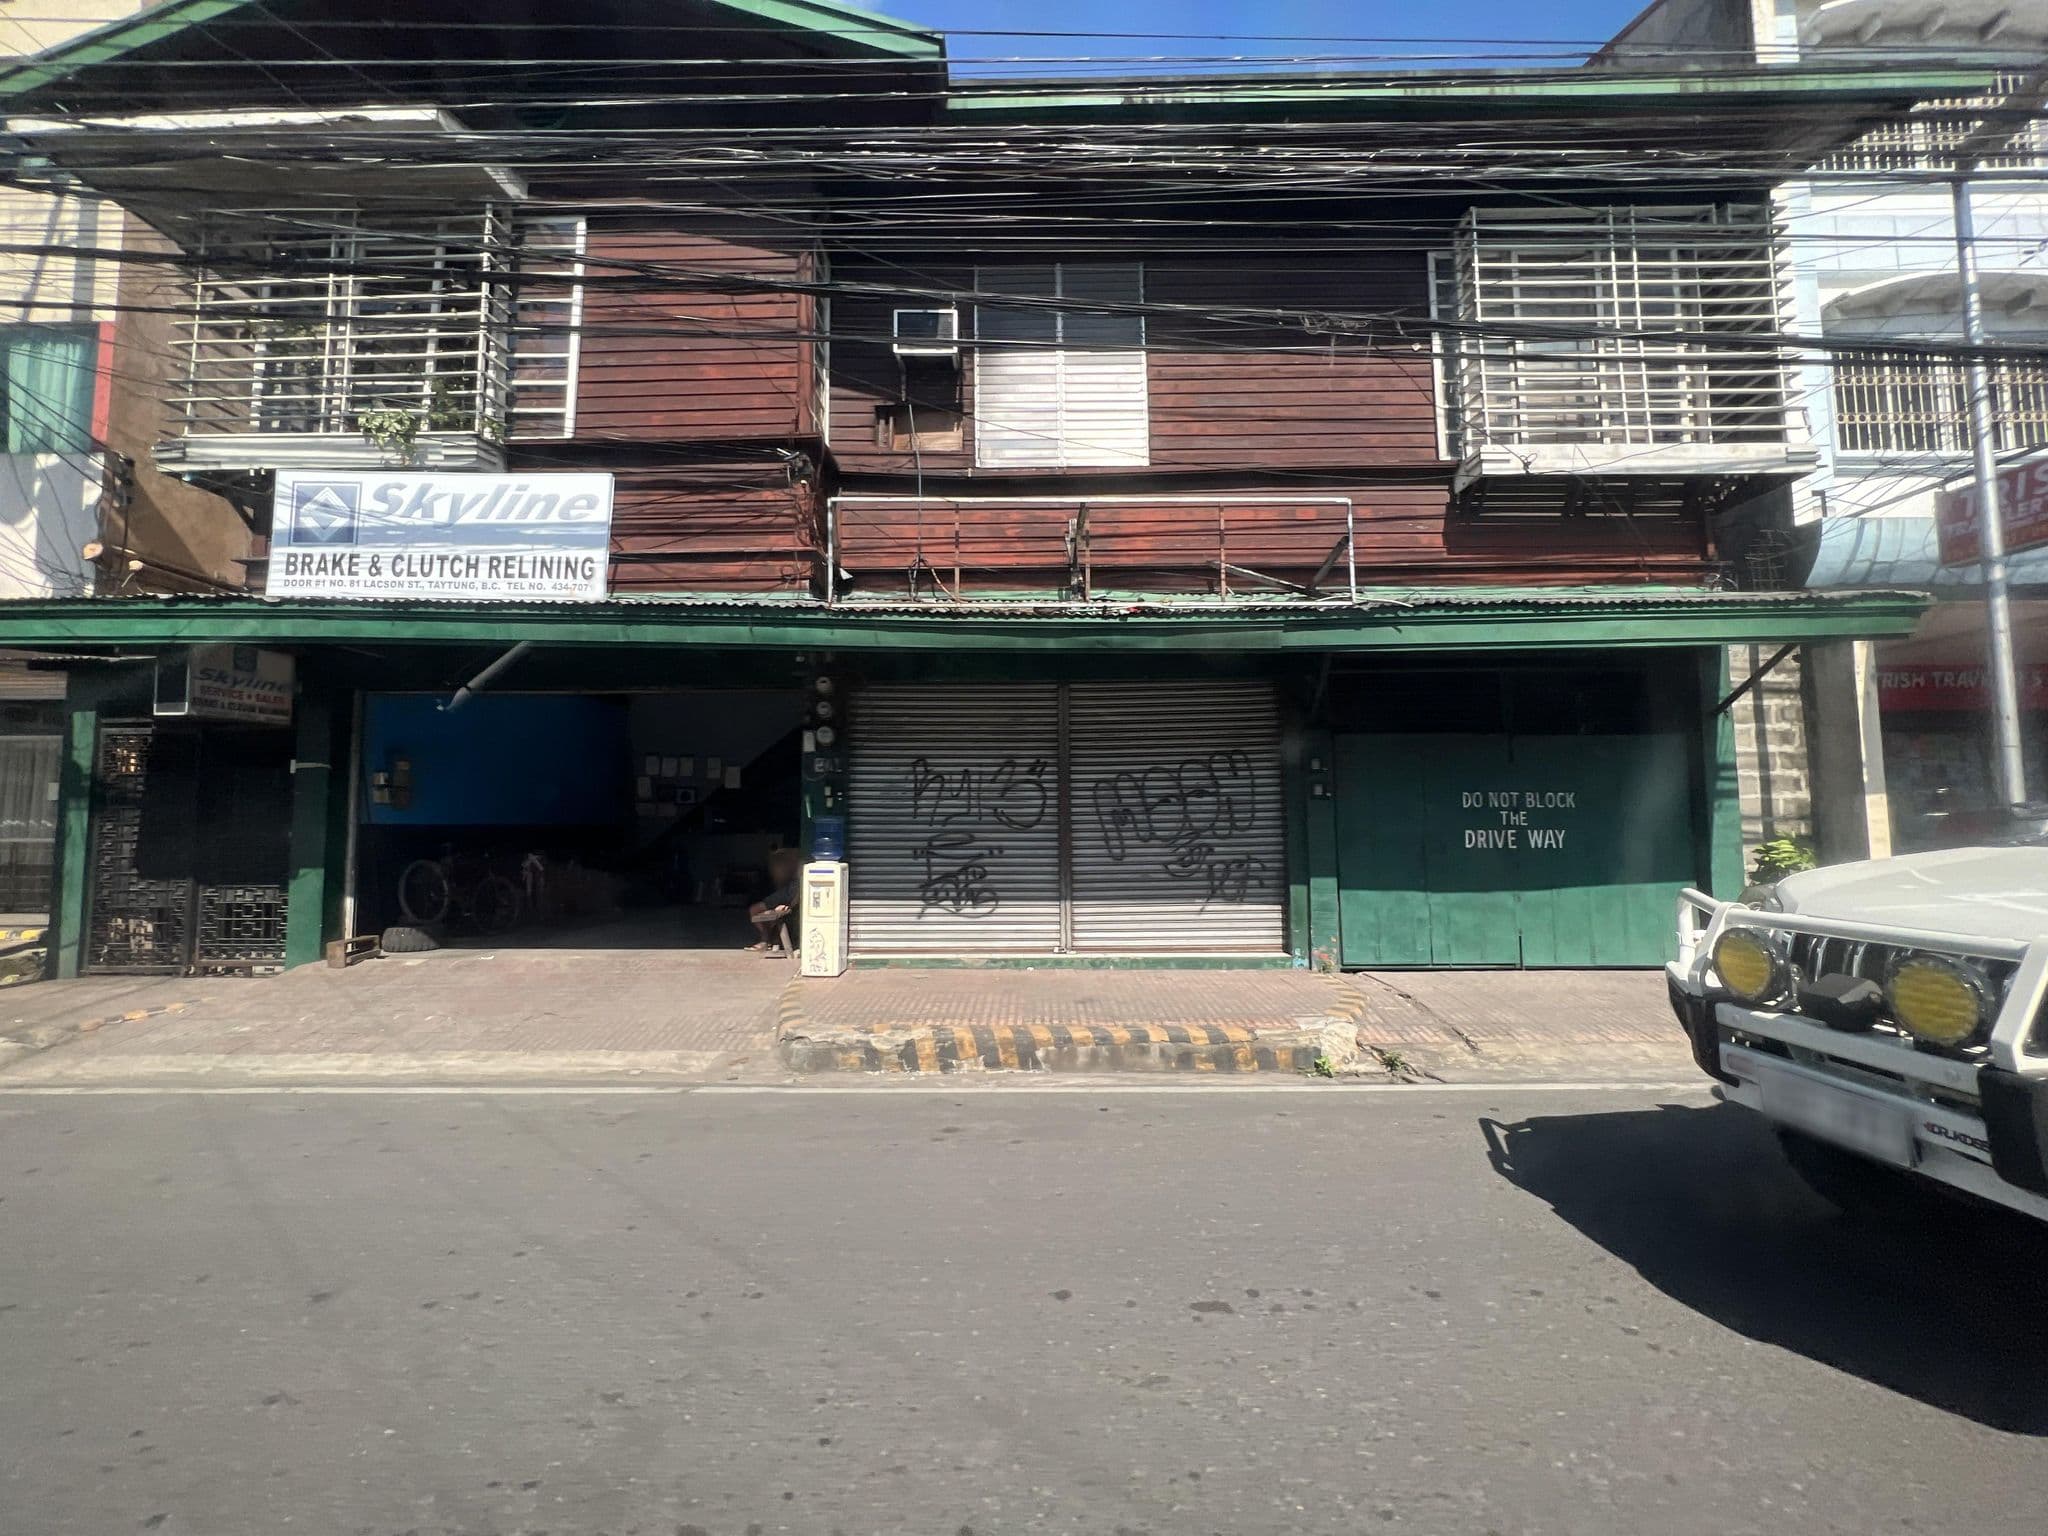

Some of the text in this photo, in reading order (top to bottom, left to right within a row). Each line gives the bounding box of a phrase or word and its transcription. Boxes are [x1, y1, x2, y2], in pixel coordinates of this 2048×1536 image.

[370, 482, 600, 528] Skyline
[285, 553, 595, 580] BRAKE & CLUTCH RELINING
[284, 579, 312, 588] DOOR
[315, 580, 326, 588] #1
[329, 580, 347, 588] NO.
[364, 580, 405, 589] LACSON
[428, 581, 479, 591] TAYTUNG,
[481, 582, 501, 591] B.C.
[507, 583, 526, 591] TEL
[529, 583, 546, 591] NO.
[1462, 792, 1576, 808] DO NOT BLOCK
[1465, 830, 1566, 849] DRIVE WAY
